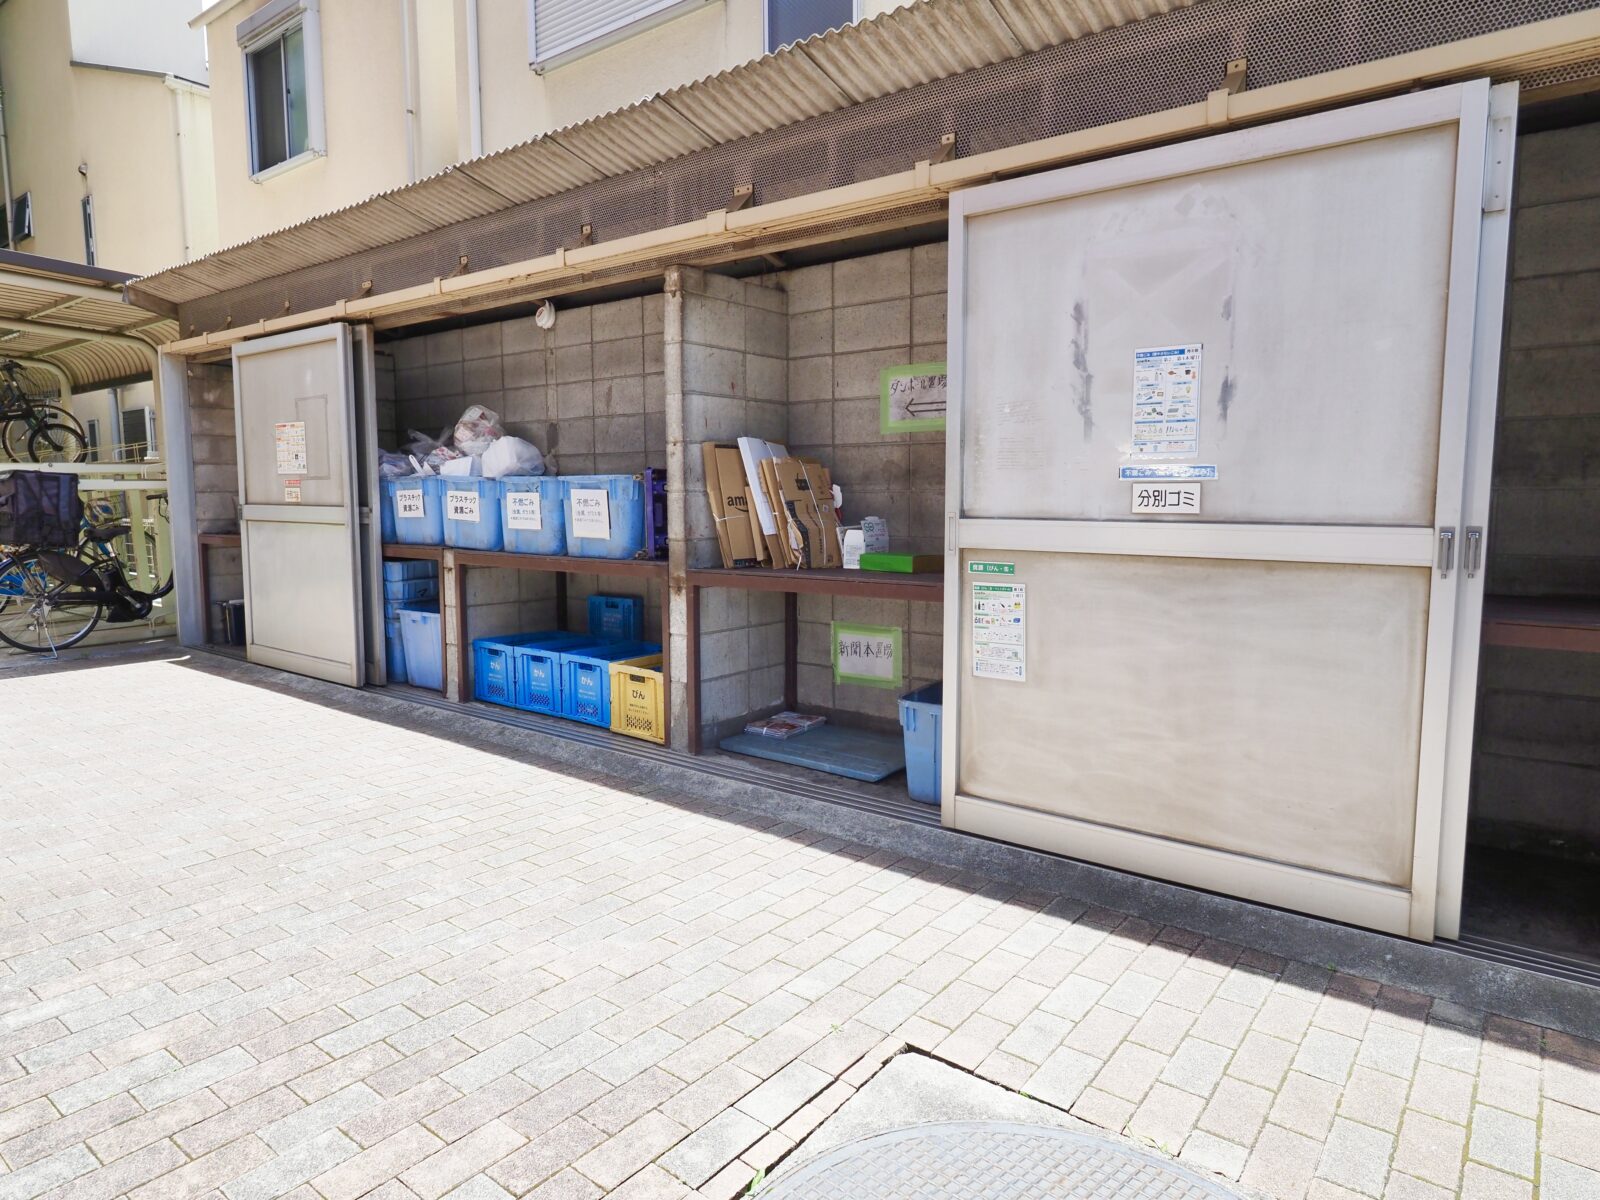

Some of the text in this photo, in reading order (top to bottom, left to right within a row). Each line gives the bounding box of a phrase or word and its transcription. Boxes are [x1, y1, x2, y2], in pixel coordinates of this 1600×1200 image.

[399, 493, 421, 502] プラスチック
[449, 495, 477, 504] プラスチック
[512, 497, 535, 507] 不燃ごみ
[1137, 489, 1195, 508] 分別ゴミ
[403, 504, 420, 512] 資源ごみ
[576, 498, 601, 508] 不燃ごみ
[453, 506, 474, 515] 資源ごみ
[838, 639, 893, 660] 新聞本置場
[490, 660, 501, 671] かん
[533, 669, 545, 679] かん
[581, 676, 593, 686] かん
[631, 689, 646, 700] びん
